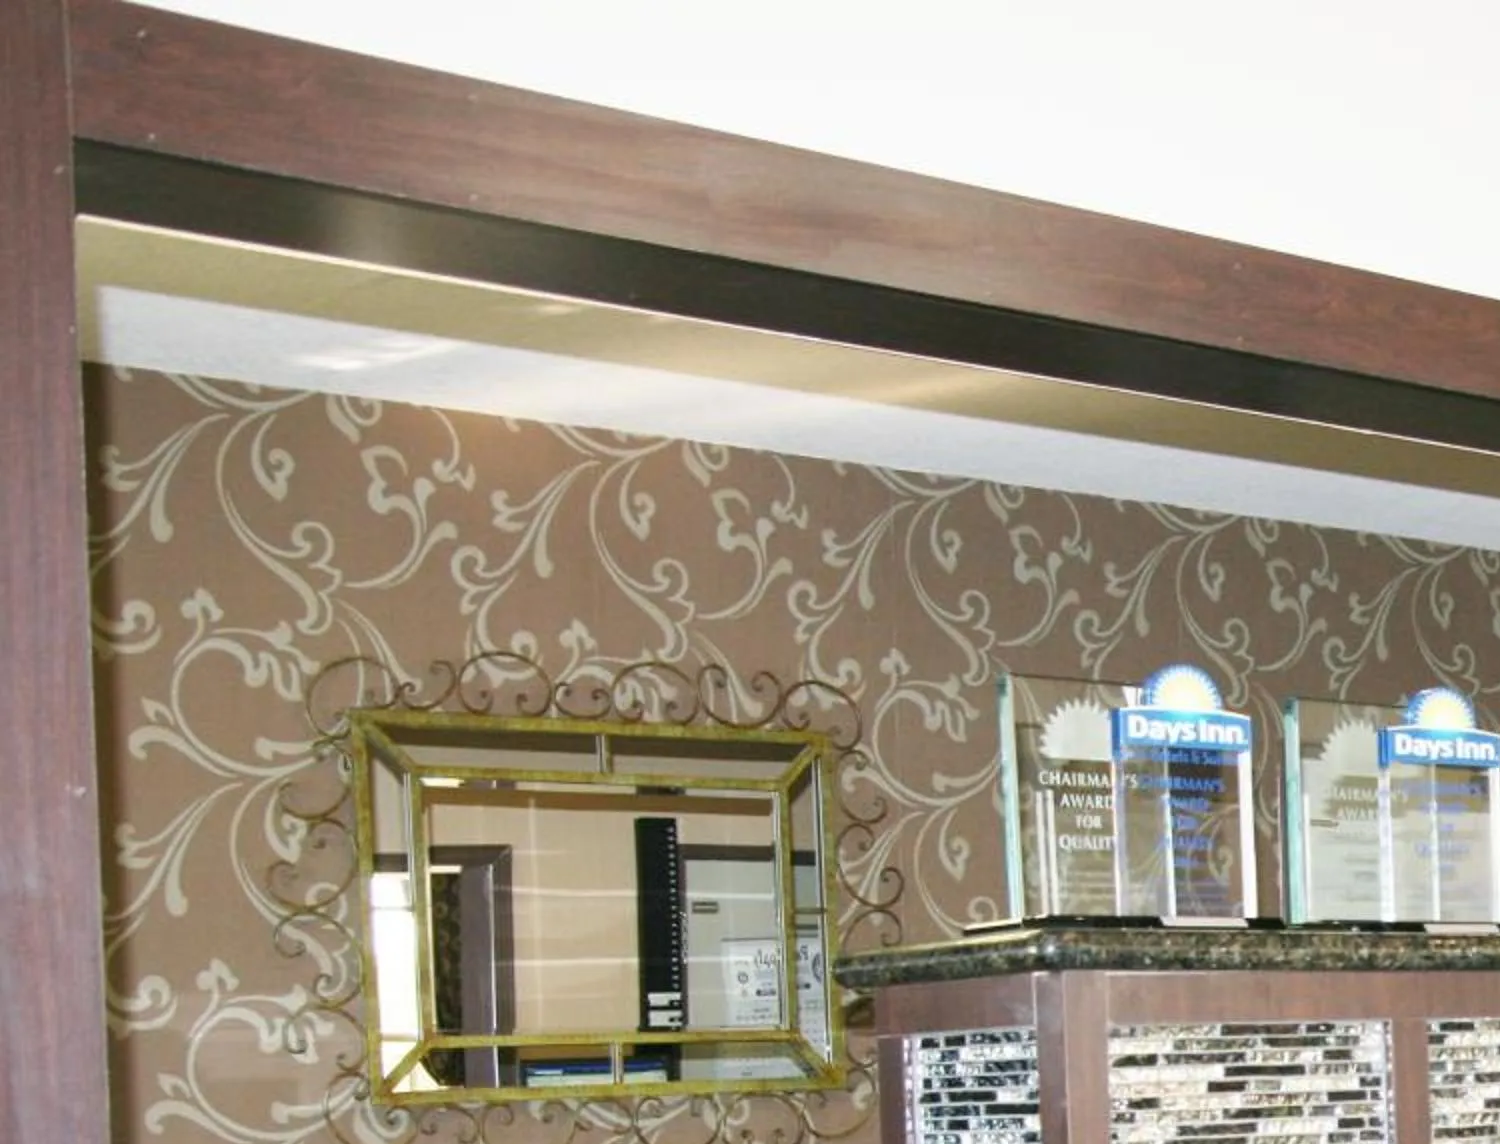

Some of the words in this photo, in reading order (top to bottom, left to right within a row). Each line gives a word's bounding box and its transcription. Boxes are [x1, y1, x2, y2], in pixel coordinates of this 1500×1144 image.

[1127, 714, 1196, 745] Days
[1198, 719, 1244, 744] Inn
[1394, 733, 1454, 760] Days
[1455, 738, 1495, 760] Inn
[1038, 769, 1138, 789] CHAIRMA'S
[1058, 834, 1117, 853] QUALIT
